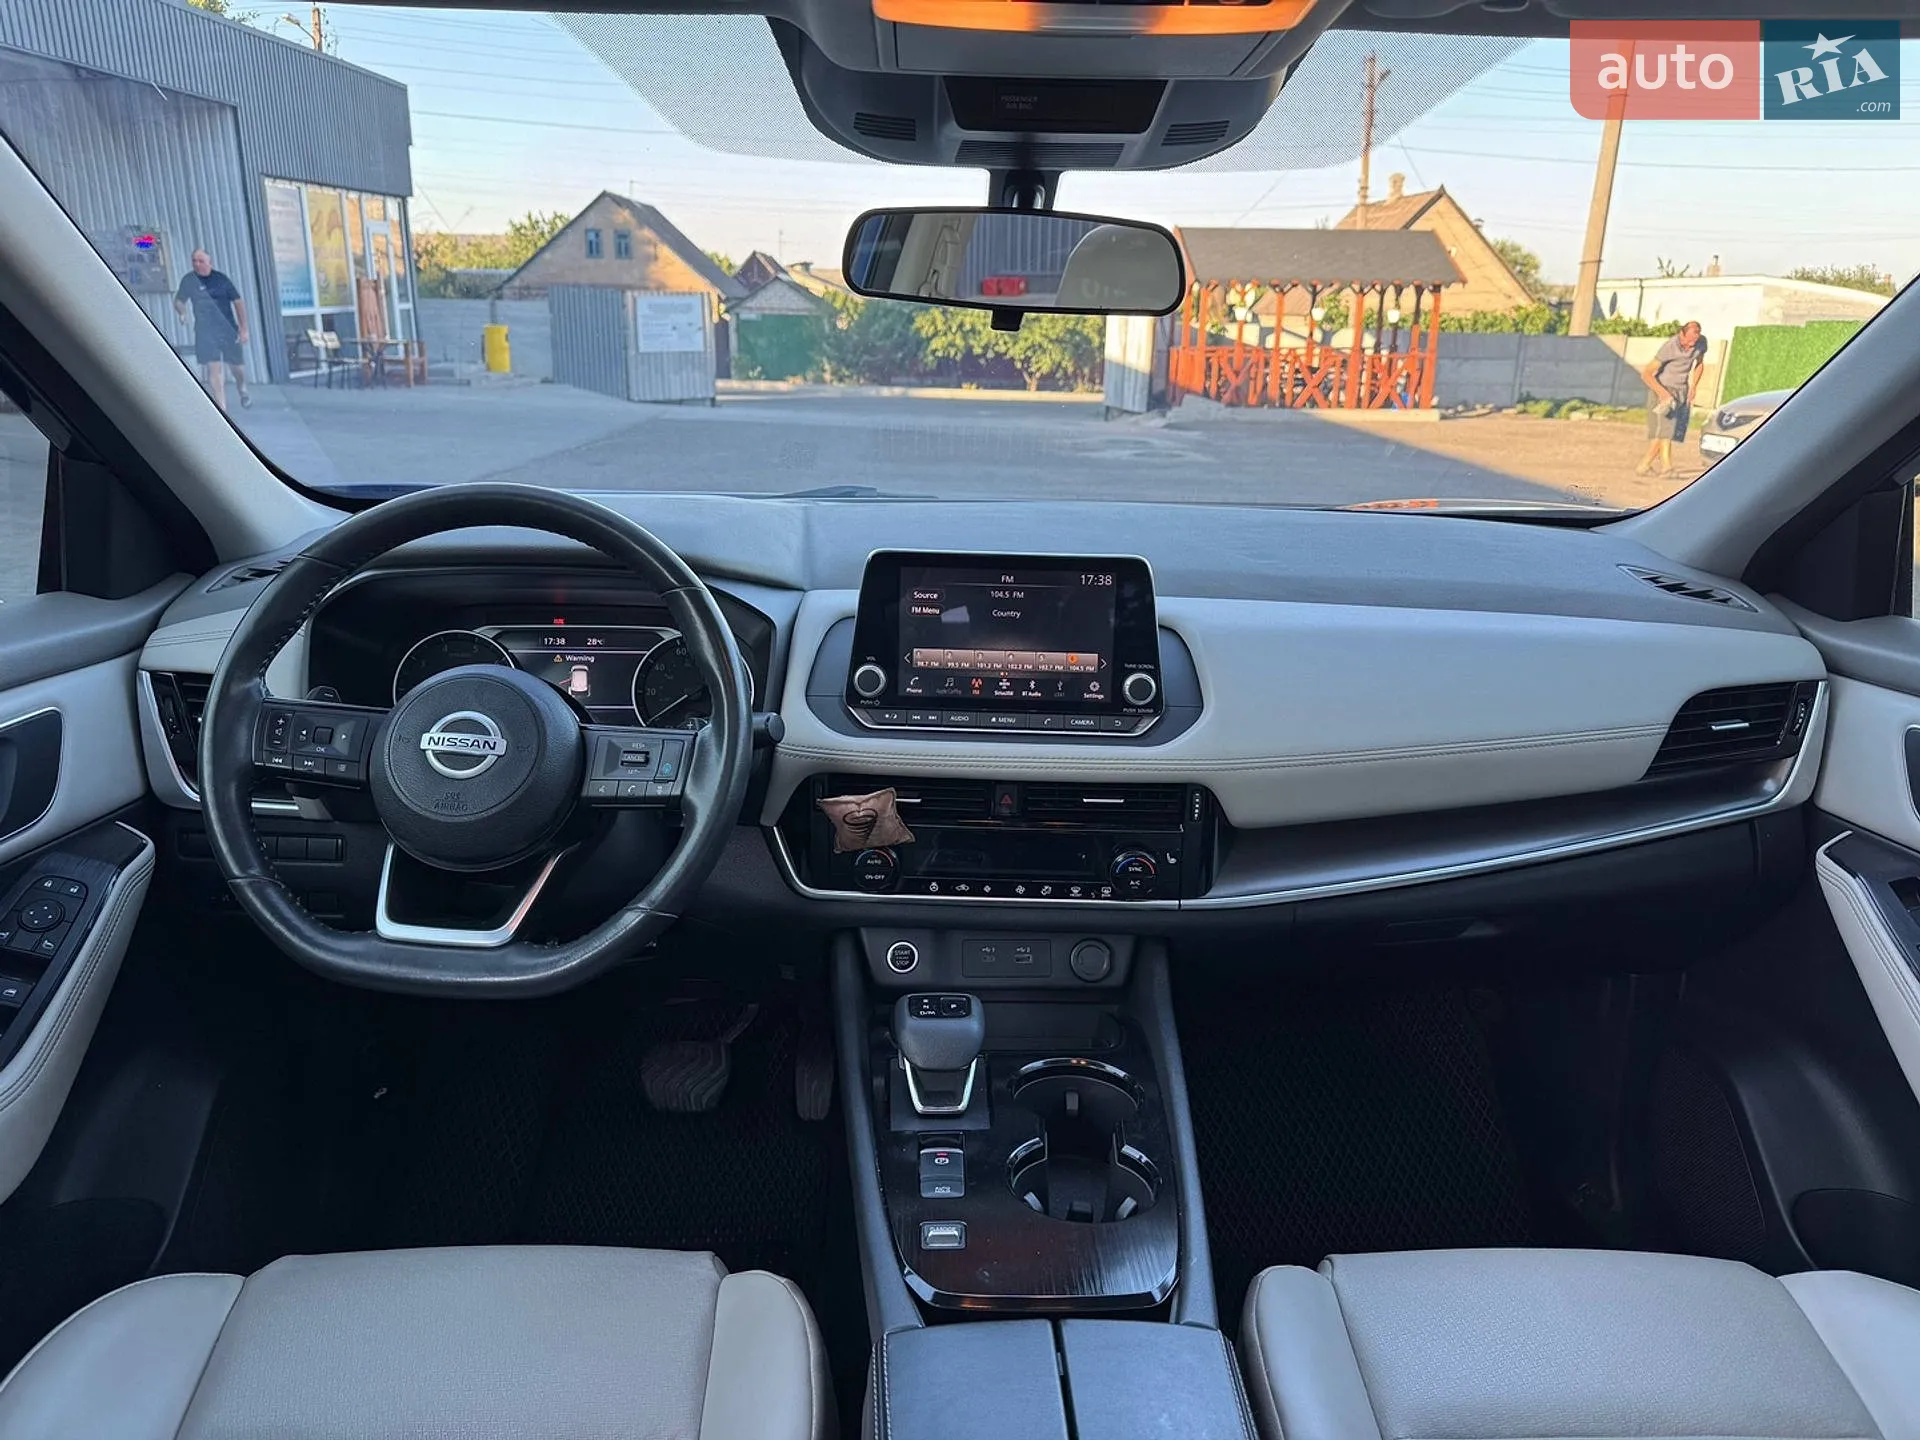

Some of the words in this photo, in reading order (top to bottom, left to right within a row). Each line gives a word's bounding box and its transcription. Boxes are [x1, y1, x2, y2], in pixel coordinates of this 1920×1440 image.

[1001, 575, 1014, 583] FM
[1080, 574, 1112, 586] 17:38
[913, 591, 938, 600] Source
[990, 590, 1009, 599] 104.5
[1013, 590, 1024, 599] FM
[911, 606, 922, 614] FM
[923, 606, 940, 615] Menu
[992, 609, 1021, 619] Country
[544, 637, 566, 645] 17:38
[565, 655, 595, 663] Warning
[1083, 692, 1105, 700] Settings
[998, 716, 1016, 725] MENU
[1070, 718, 1095, 727] CAMERA
[427, 736, 497, 751] NISSAN
